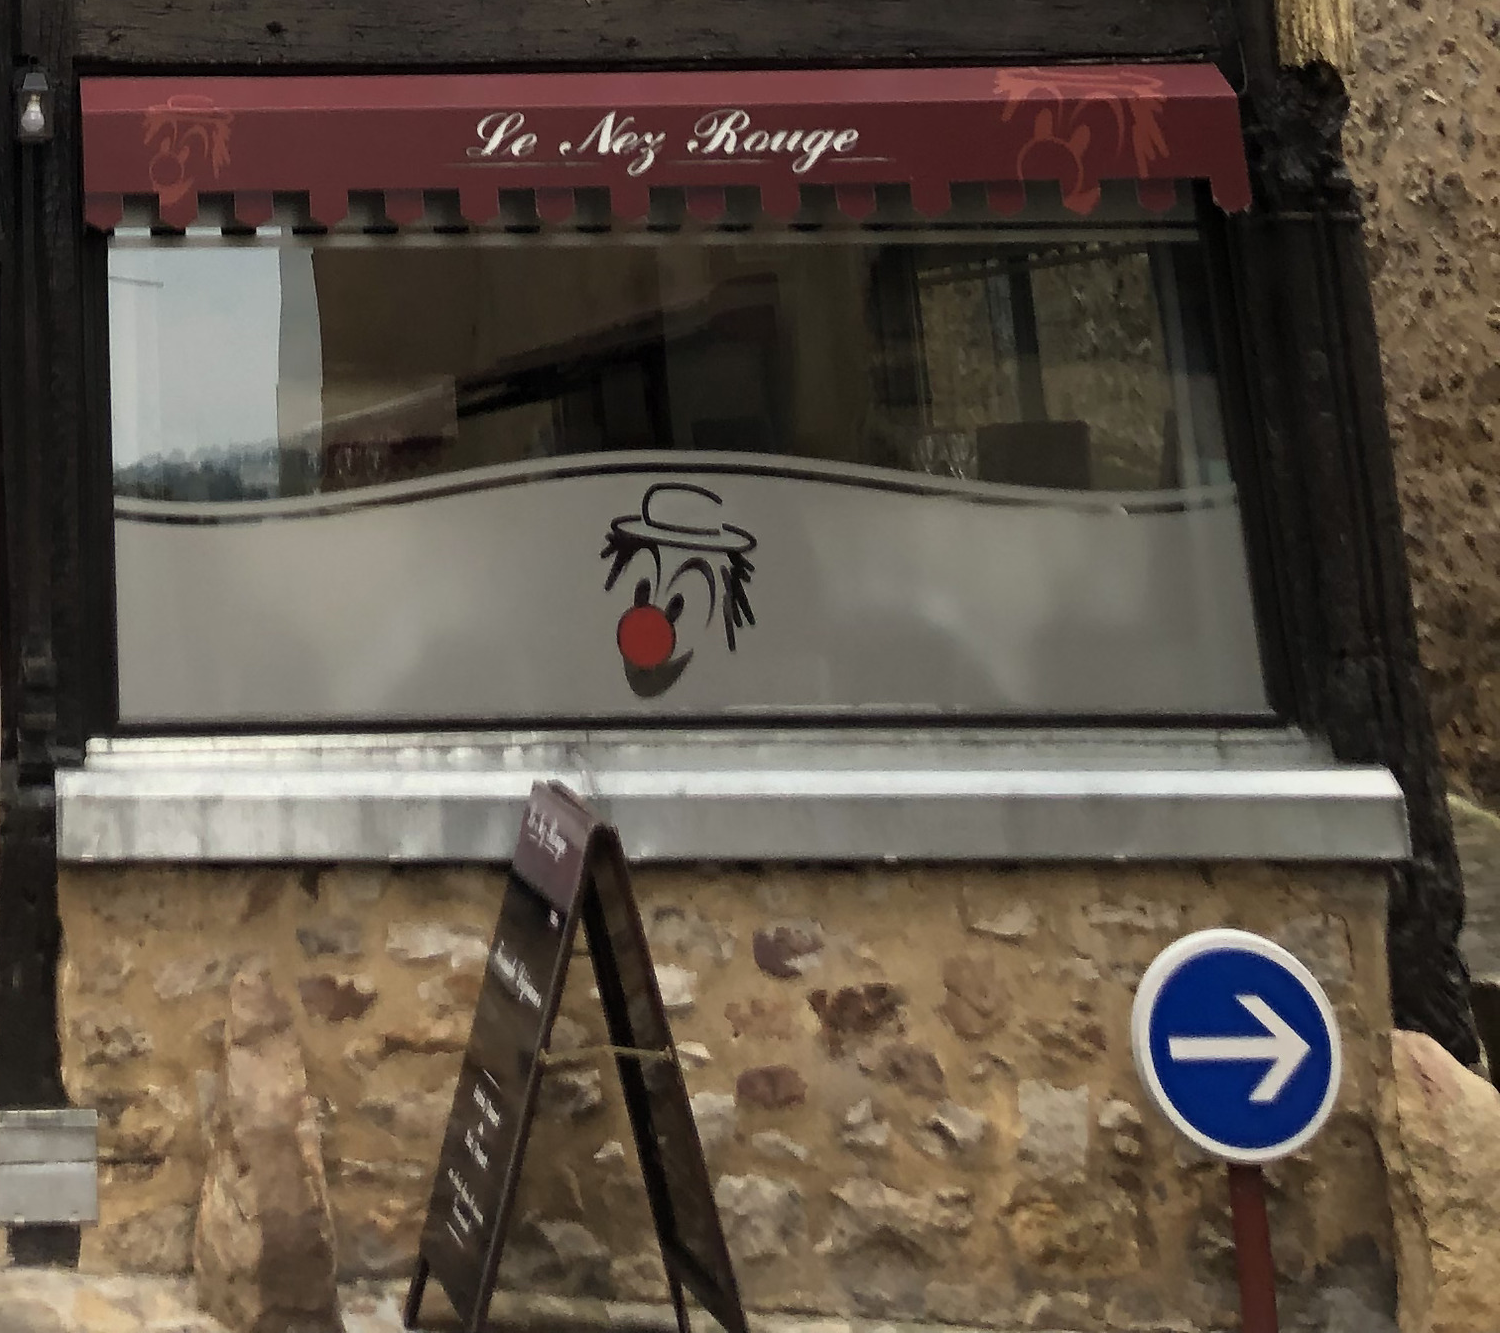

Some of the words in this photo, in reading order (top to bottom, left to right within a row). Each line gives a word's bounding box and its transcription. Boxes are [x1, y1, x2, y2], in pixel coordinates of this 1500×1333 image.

[466, 111, 538, 158] Le
[559, 110, 667, 177] Nez
[687, 109, 861, 174] Rouge
